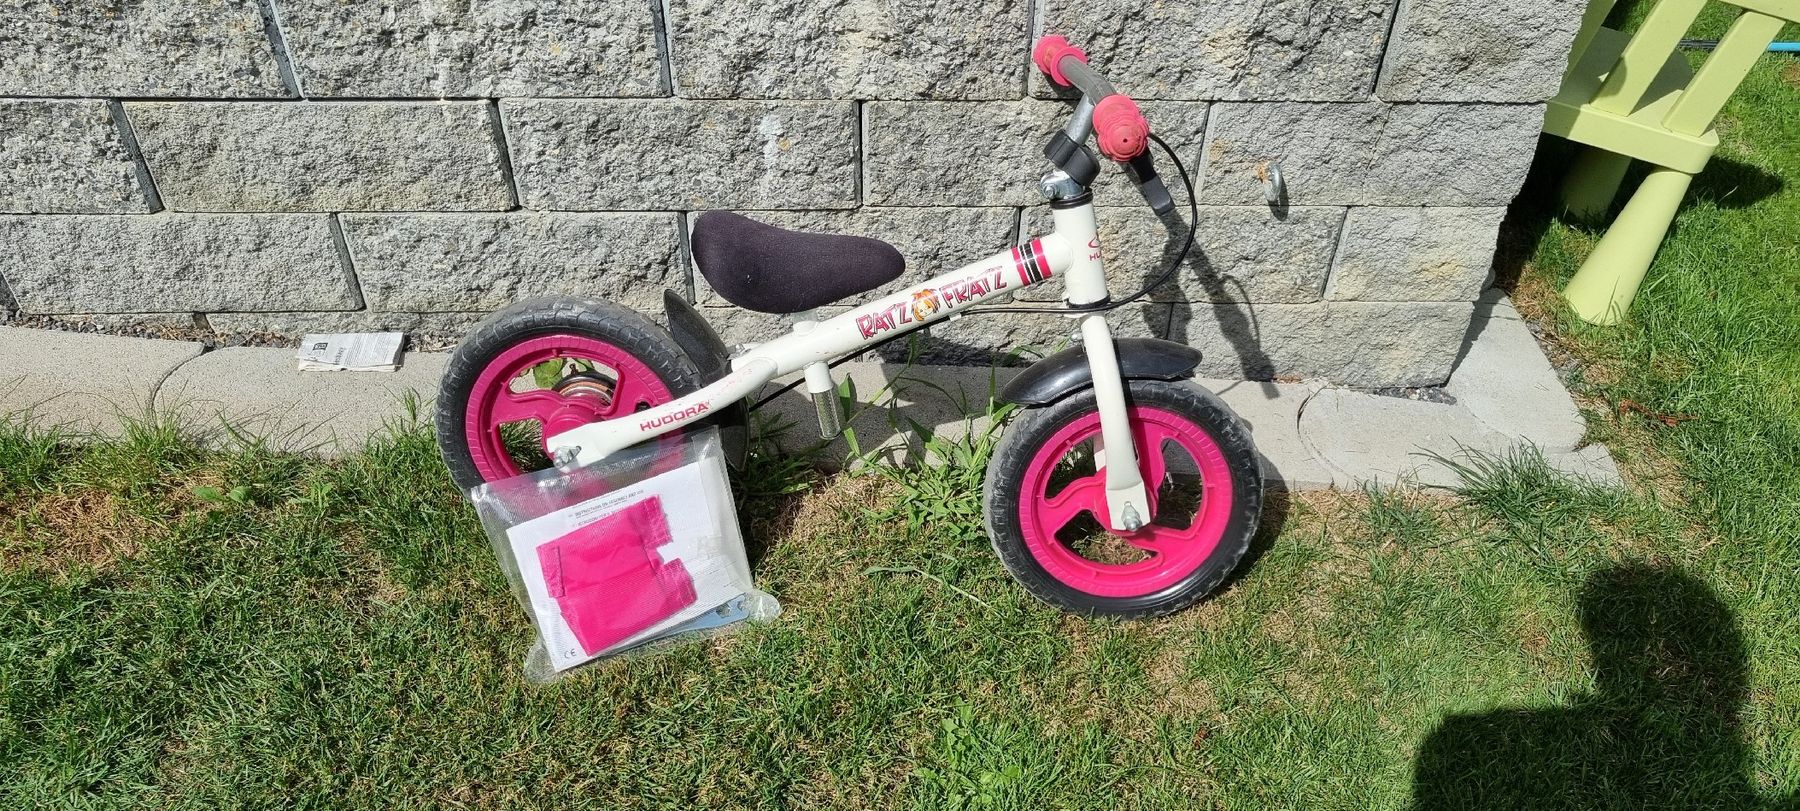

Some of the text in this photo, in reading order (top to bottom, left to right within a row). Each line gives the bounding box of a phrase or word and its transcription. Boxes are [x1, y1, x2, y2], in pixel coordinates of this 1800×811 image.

[856, 266, 1007, 340] RATZ FRATZ
[640, 402, 709, 432] HUDORA
